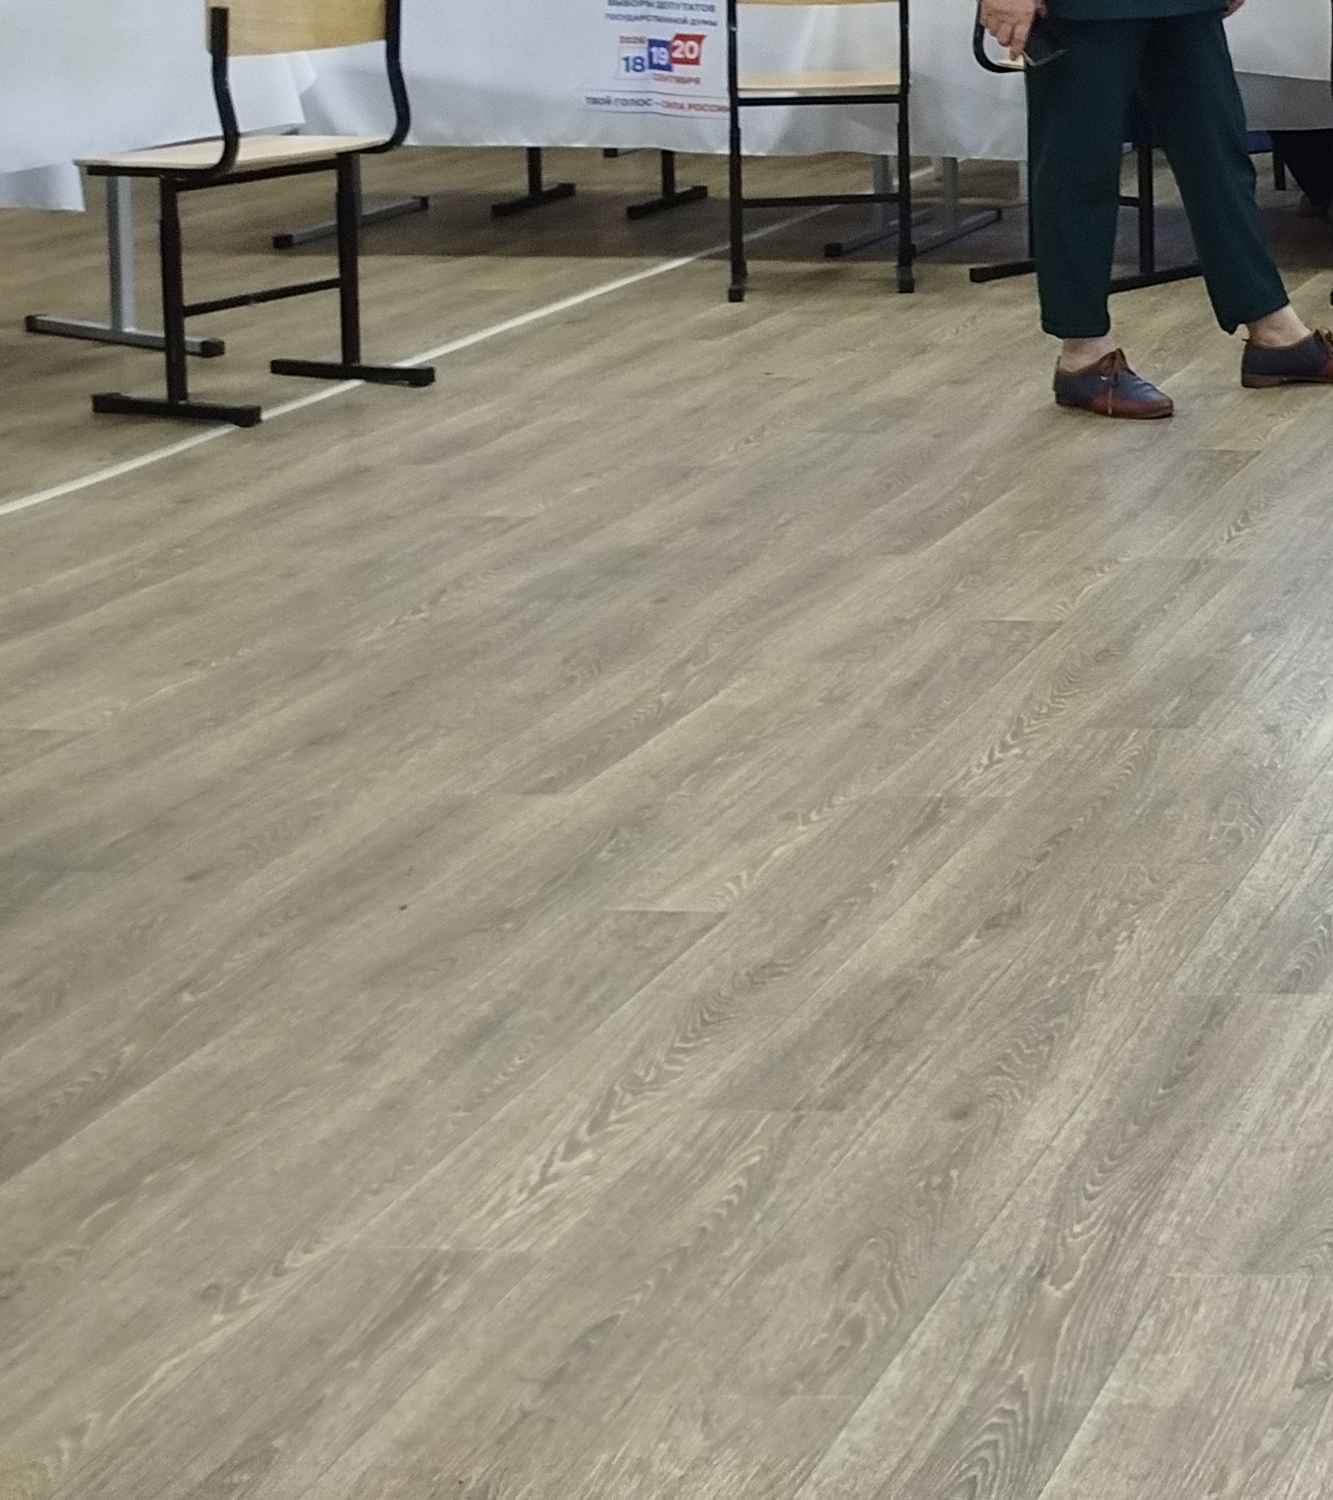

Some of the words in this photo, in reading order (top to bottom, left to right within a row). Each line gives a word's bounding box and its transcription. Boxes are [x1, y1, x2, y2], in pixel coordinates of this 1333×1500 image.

[622, 56, 646, 73] 18
[651, 45, 670, 66] 19
[671, 40, 700, 60] 20
